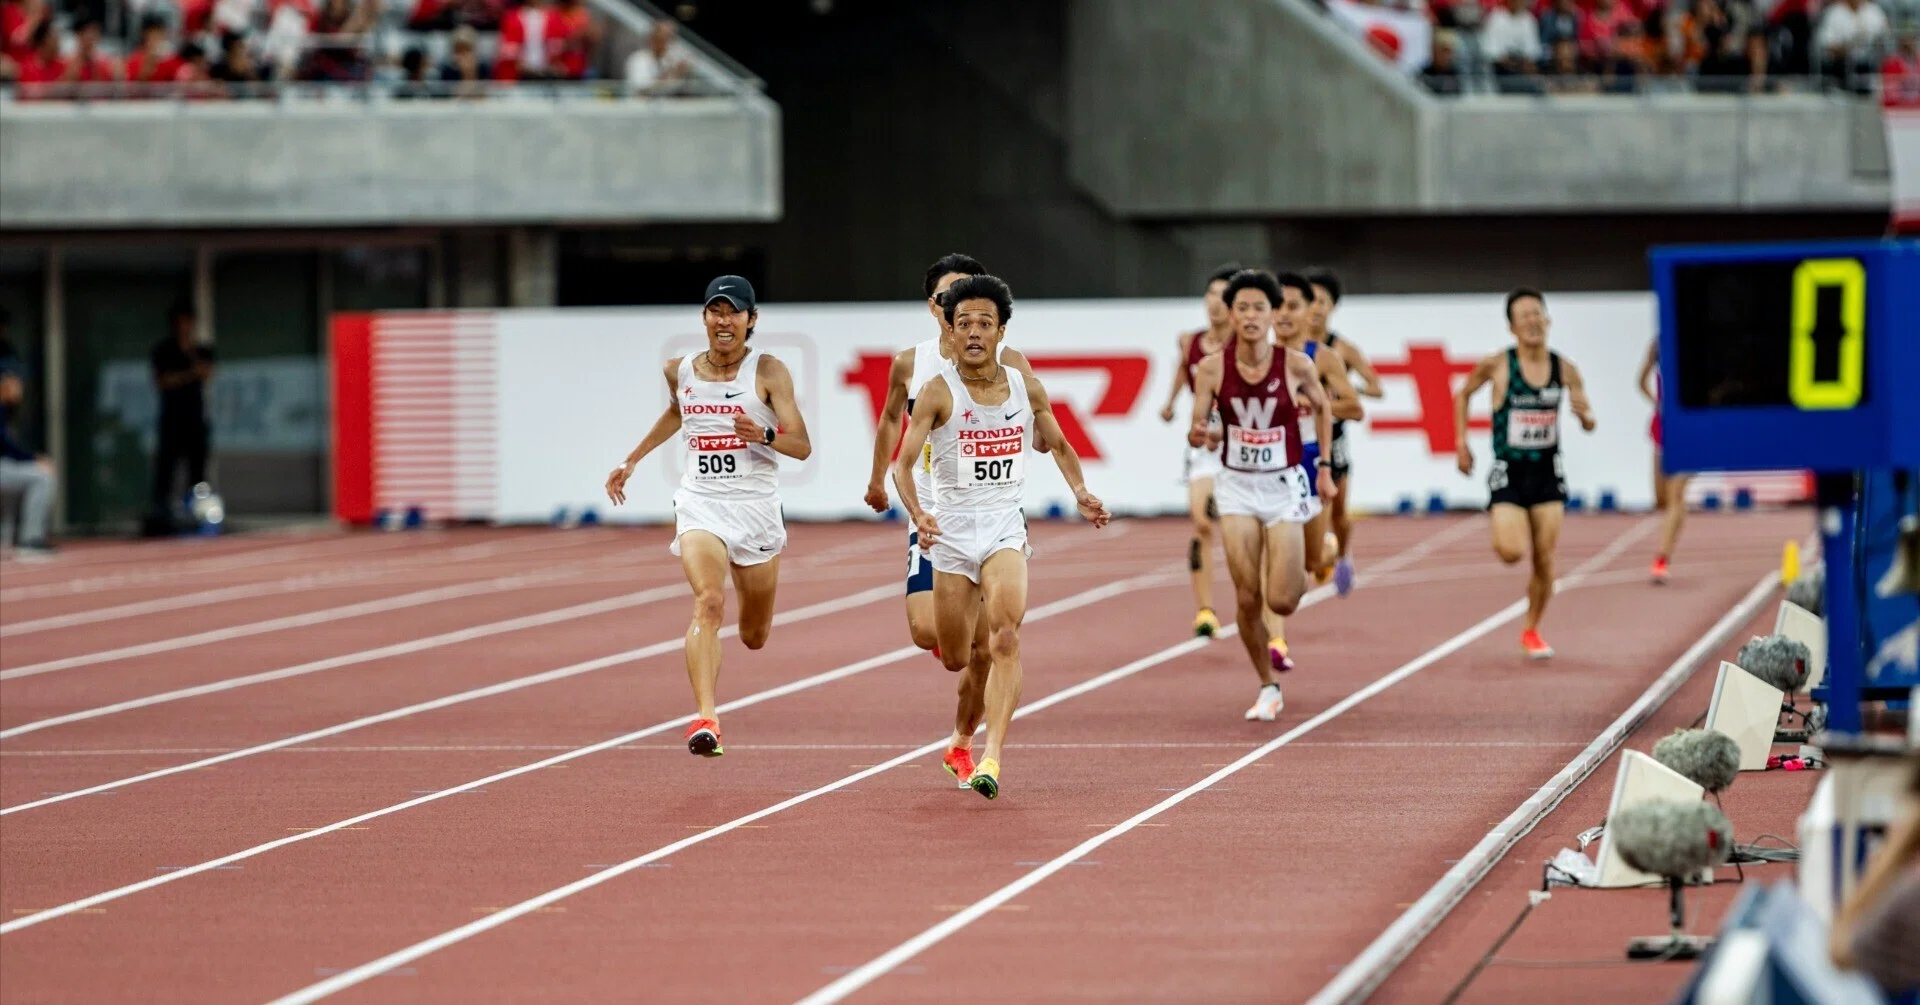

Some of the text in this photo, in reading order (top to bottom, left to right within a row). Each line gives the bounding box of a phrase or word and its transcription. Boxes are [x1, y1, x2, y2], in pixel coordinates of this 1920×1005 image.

[1789, 258, 1866, 410] 0
[683, 404, 746, 415] HONDA
[1230, 397, 1278, 429] W
[958, 425, 1024, 440] HONDA
[699, 437, 745, 449] ヤマザキ
[978, 440, 1021, 454] ヤマザキ
[698, 453, 737, 474] 509
[1240, 446, 1272, 464] 570
[974, 458, 1013, 481] 507
